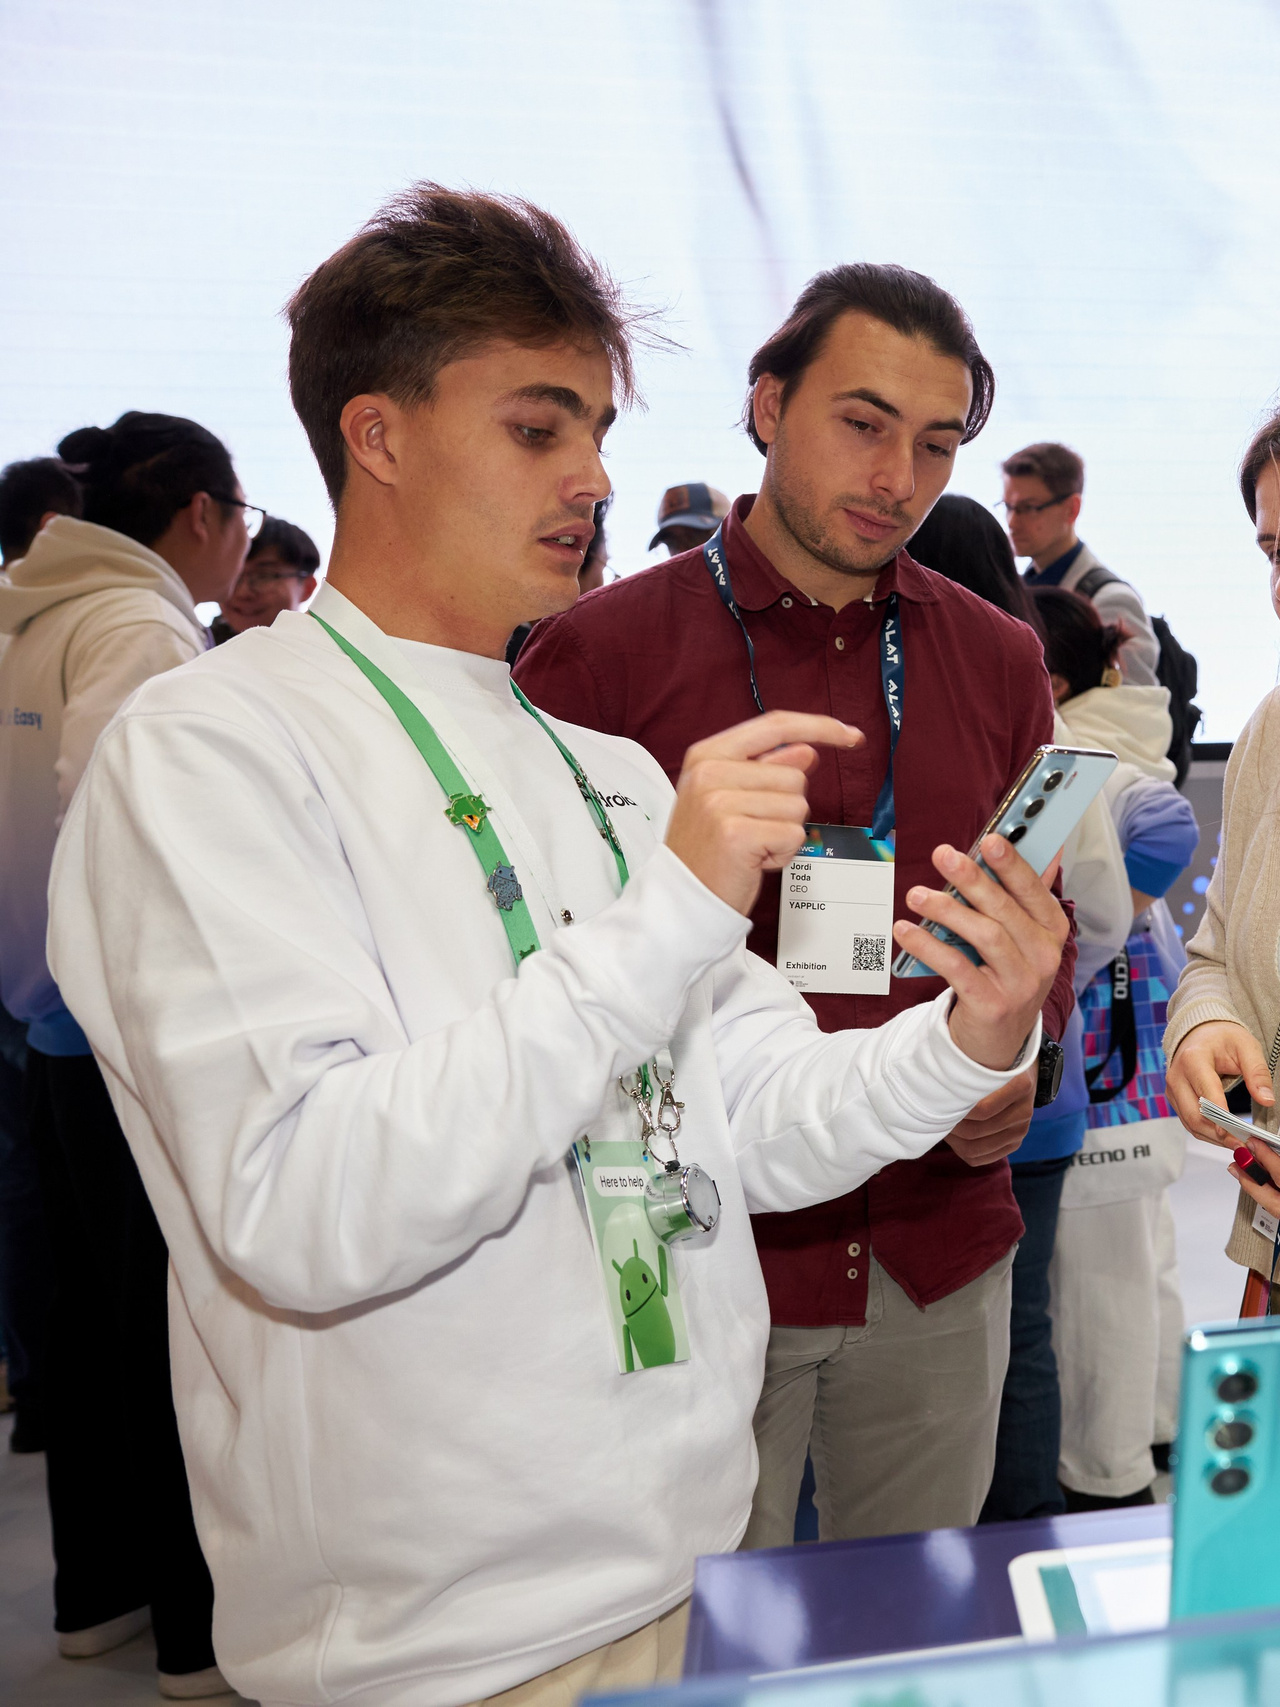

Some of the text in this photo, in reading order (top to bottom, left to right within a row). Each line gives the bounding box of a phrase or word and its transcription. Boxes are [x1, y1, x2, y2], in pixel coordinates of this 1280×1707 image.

[790, 862, 812, 871] Jordi
[790, 873, 811, 881] Toda
[789, 885, 808, 893] CEO
[789, 902, 826, 911] YAPPLIC
[786, 961, 827, 971] Exhibition
[1133, 1144, 1151, 1159] AI
[600, 1175, 644, 1190] Here to help
